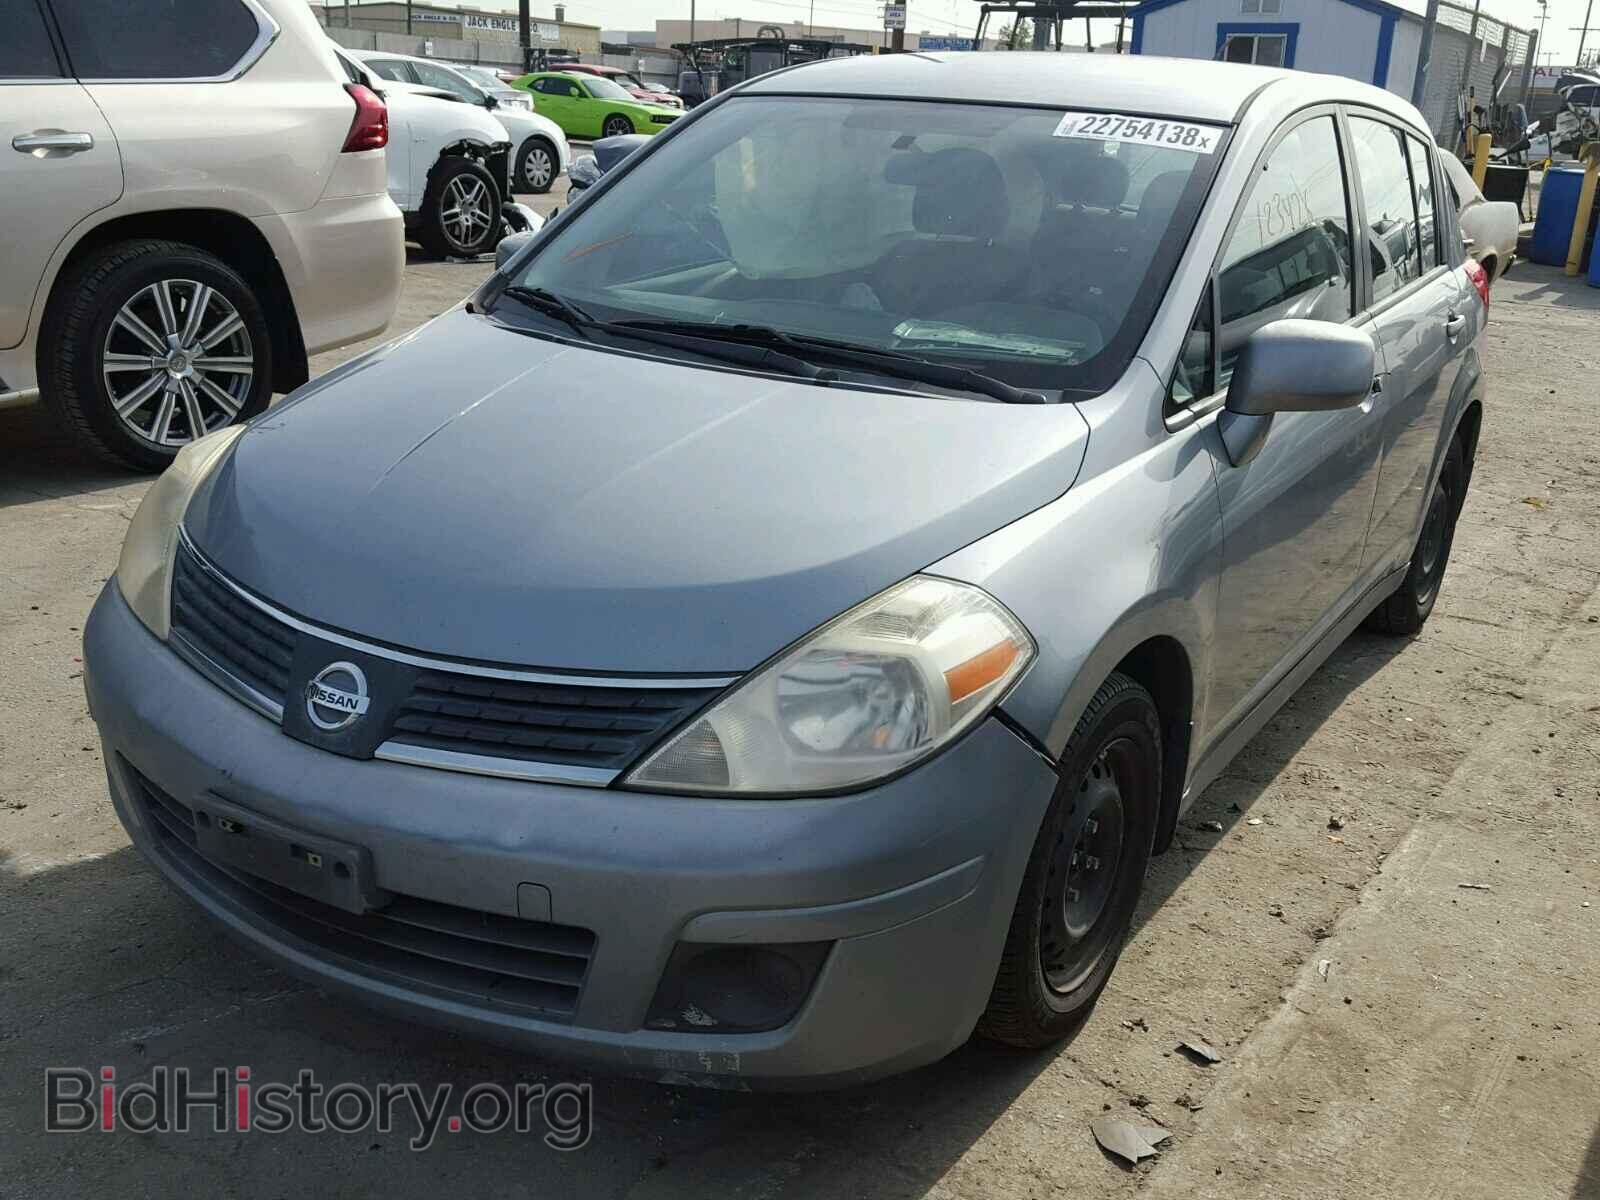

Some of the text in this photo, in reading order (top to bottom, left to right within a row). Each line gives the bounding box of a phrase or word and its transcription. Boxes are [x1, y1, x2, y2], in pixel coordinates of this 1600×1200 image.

[466, 15, 488, 28] JACK
[491, 19, 516, 31] ENGLE
[309, 682, 360, 710] NISSAN
